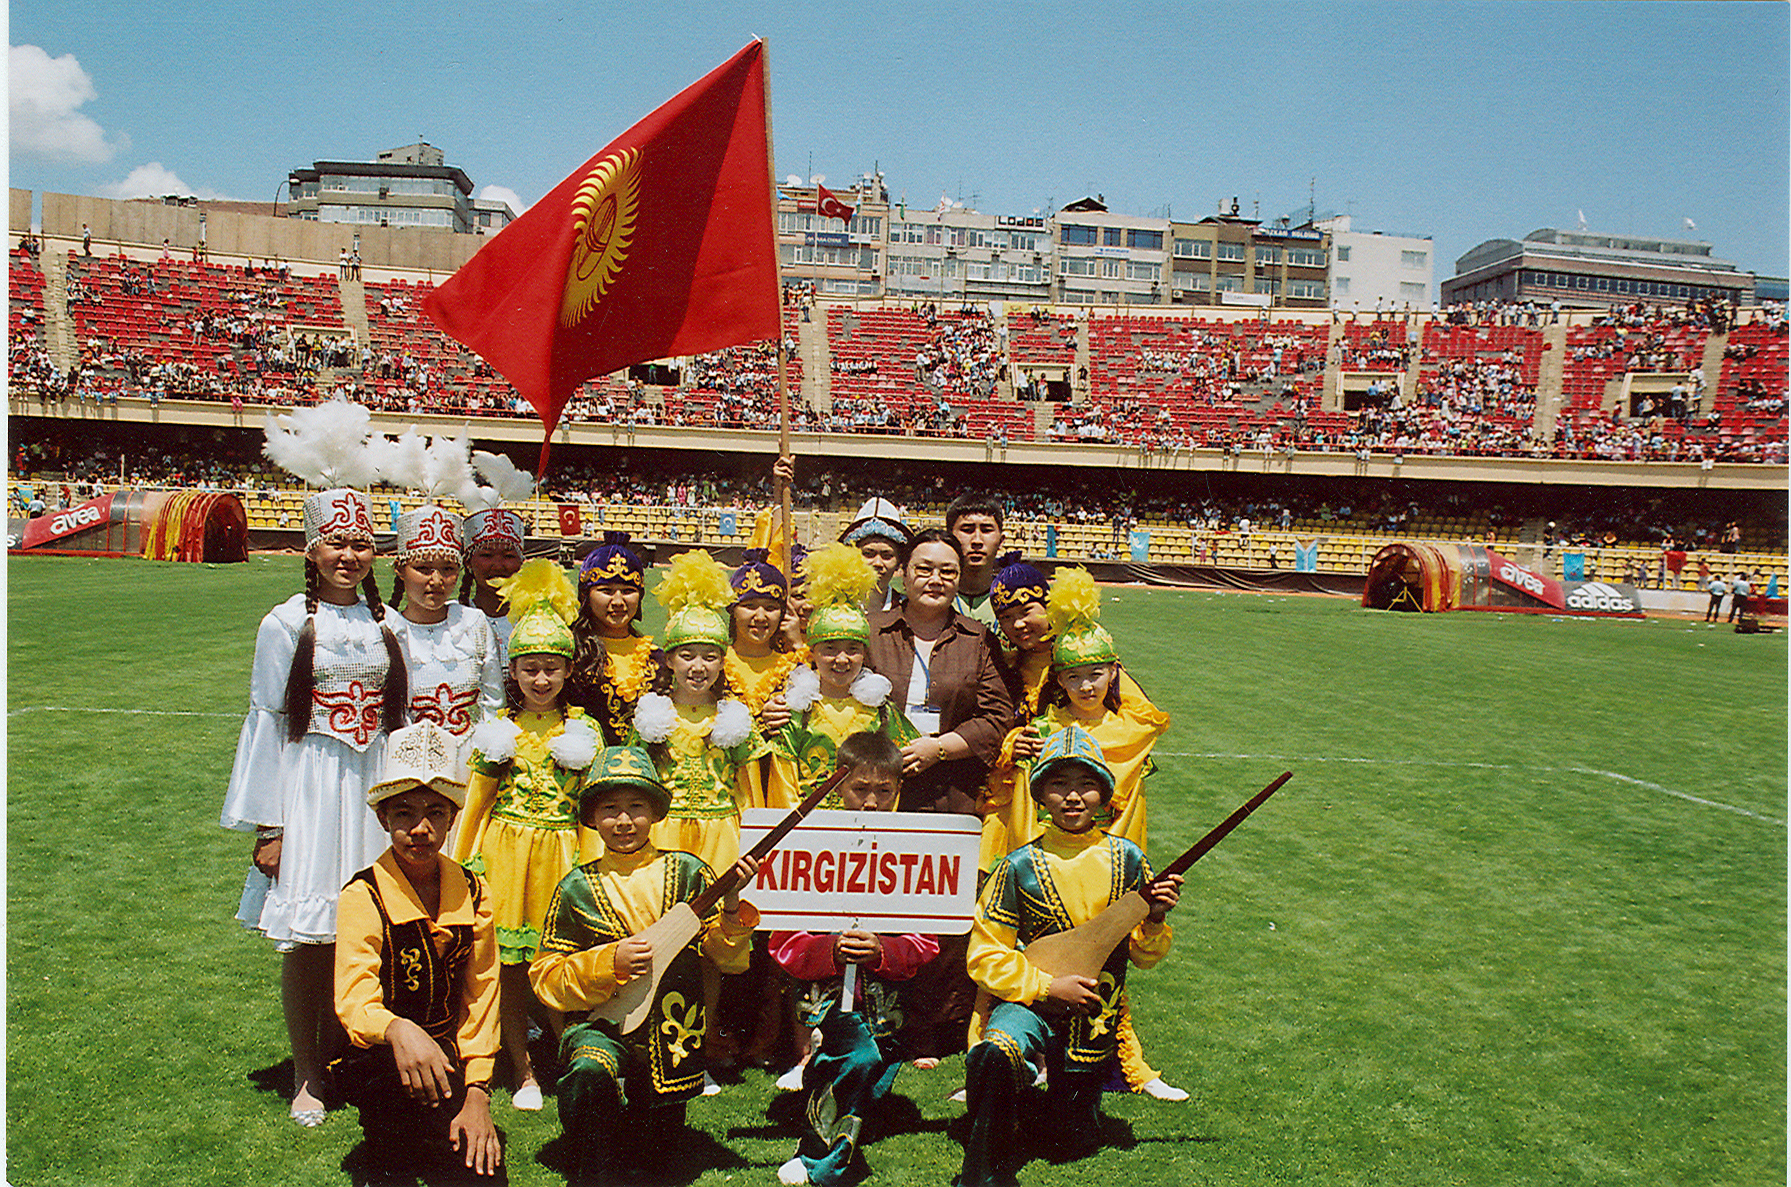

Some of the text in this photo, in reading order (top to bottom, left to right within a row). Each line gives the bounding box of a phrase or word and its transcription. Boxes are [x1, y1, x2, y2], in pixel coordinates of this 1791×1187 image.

[50, 505, 101, 535] avea
[1500, 562, 1545, 595] avea
[1567, 591, 1634, 611] adidas
[756, 842, 960, 895] KIRGIZİSTAN
